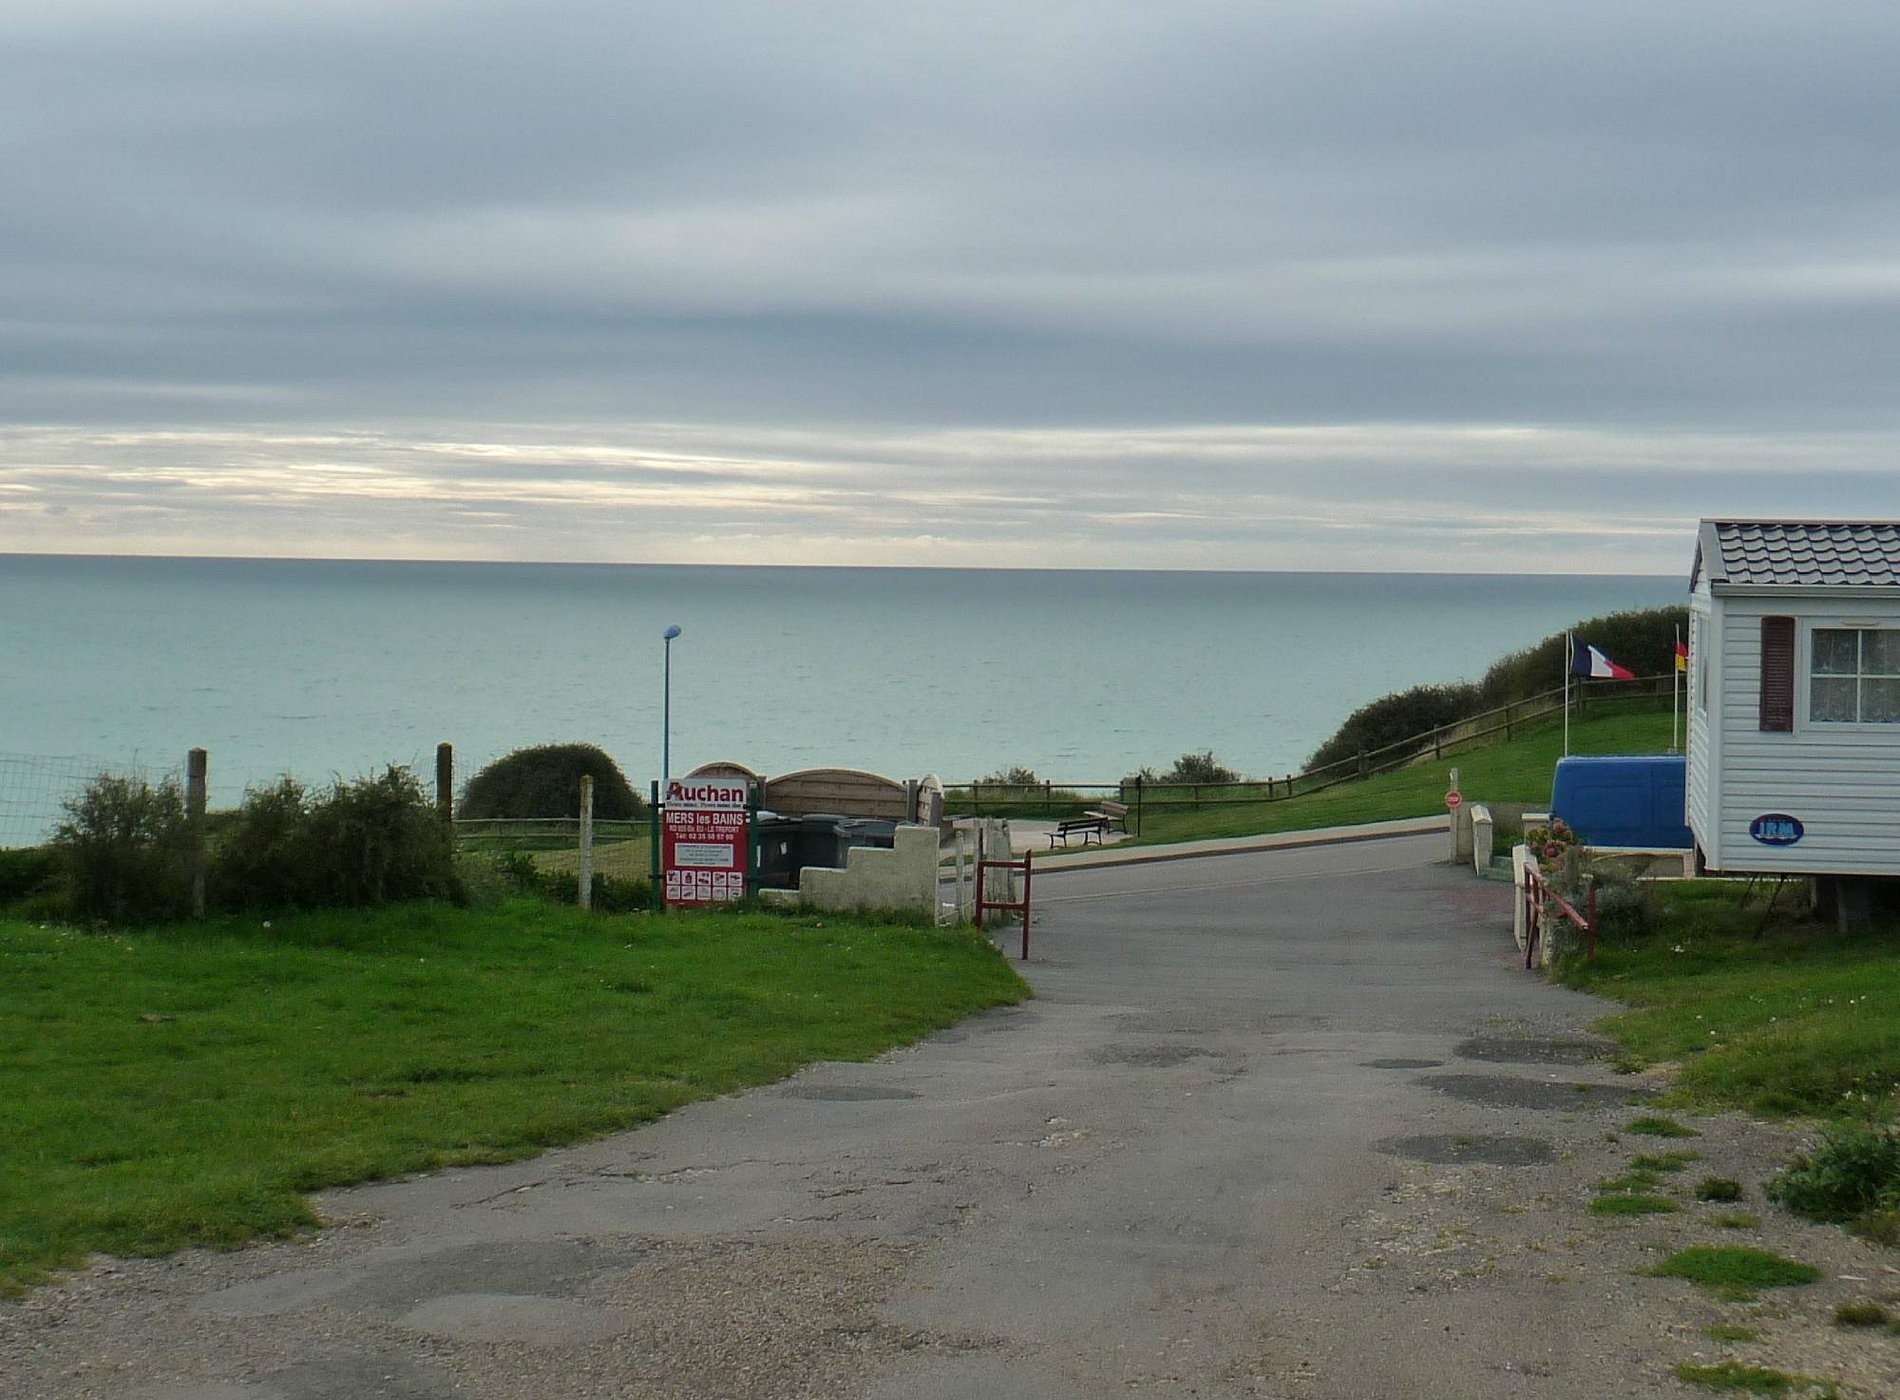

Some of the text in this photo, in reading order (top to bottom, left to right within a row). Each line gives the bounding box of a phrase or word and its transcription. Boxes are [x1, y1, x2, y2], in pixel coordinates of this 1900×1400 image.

[666, 782, 743, 802] Auchan
[666, 812, 743, 826] MERS les BAINS
